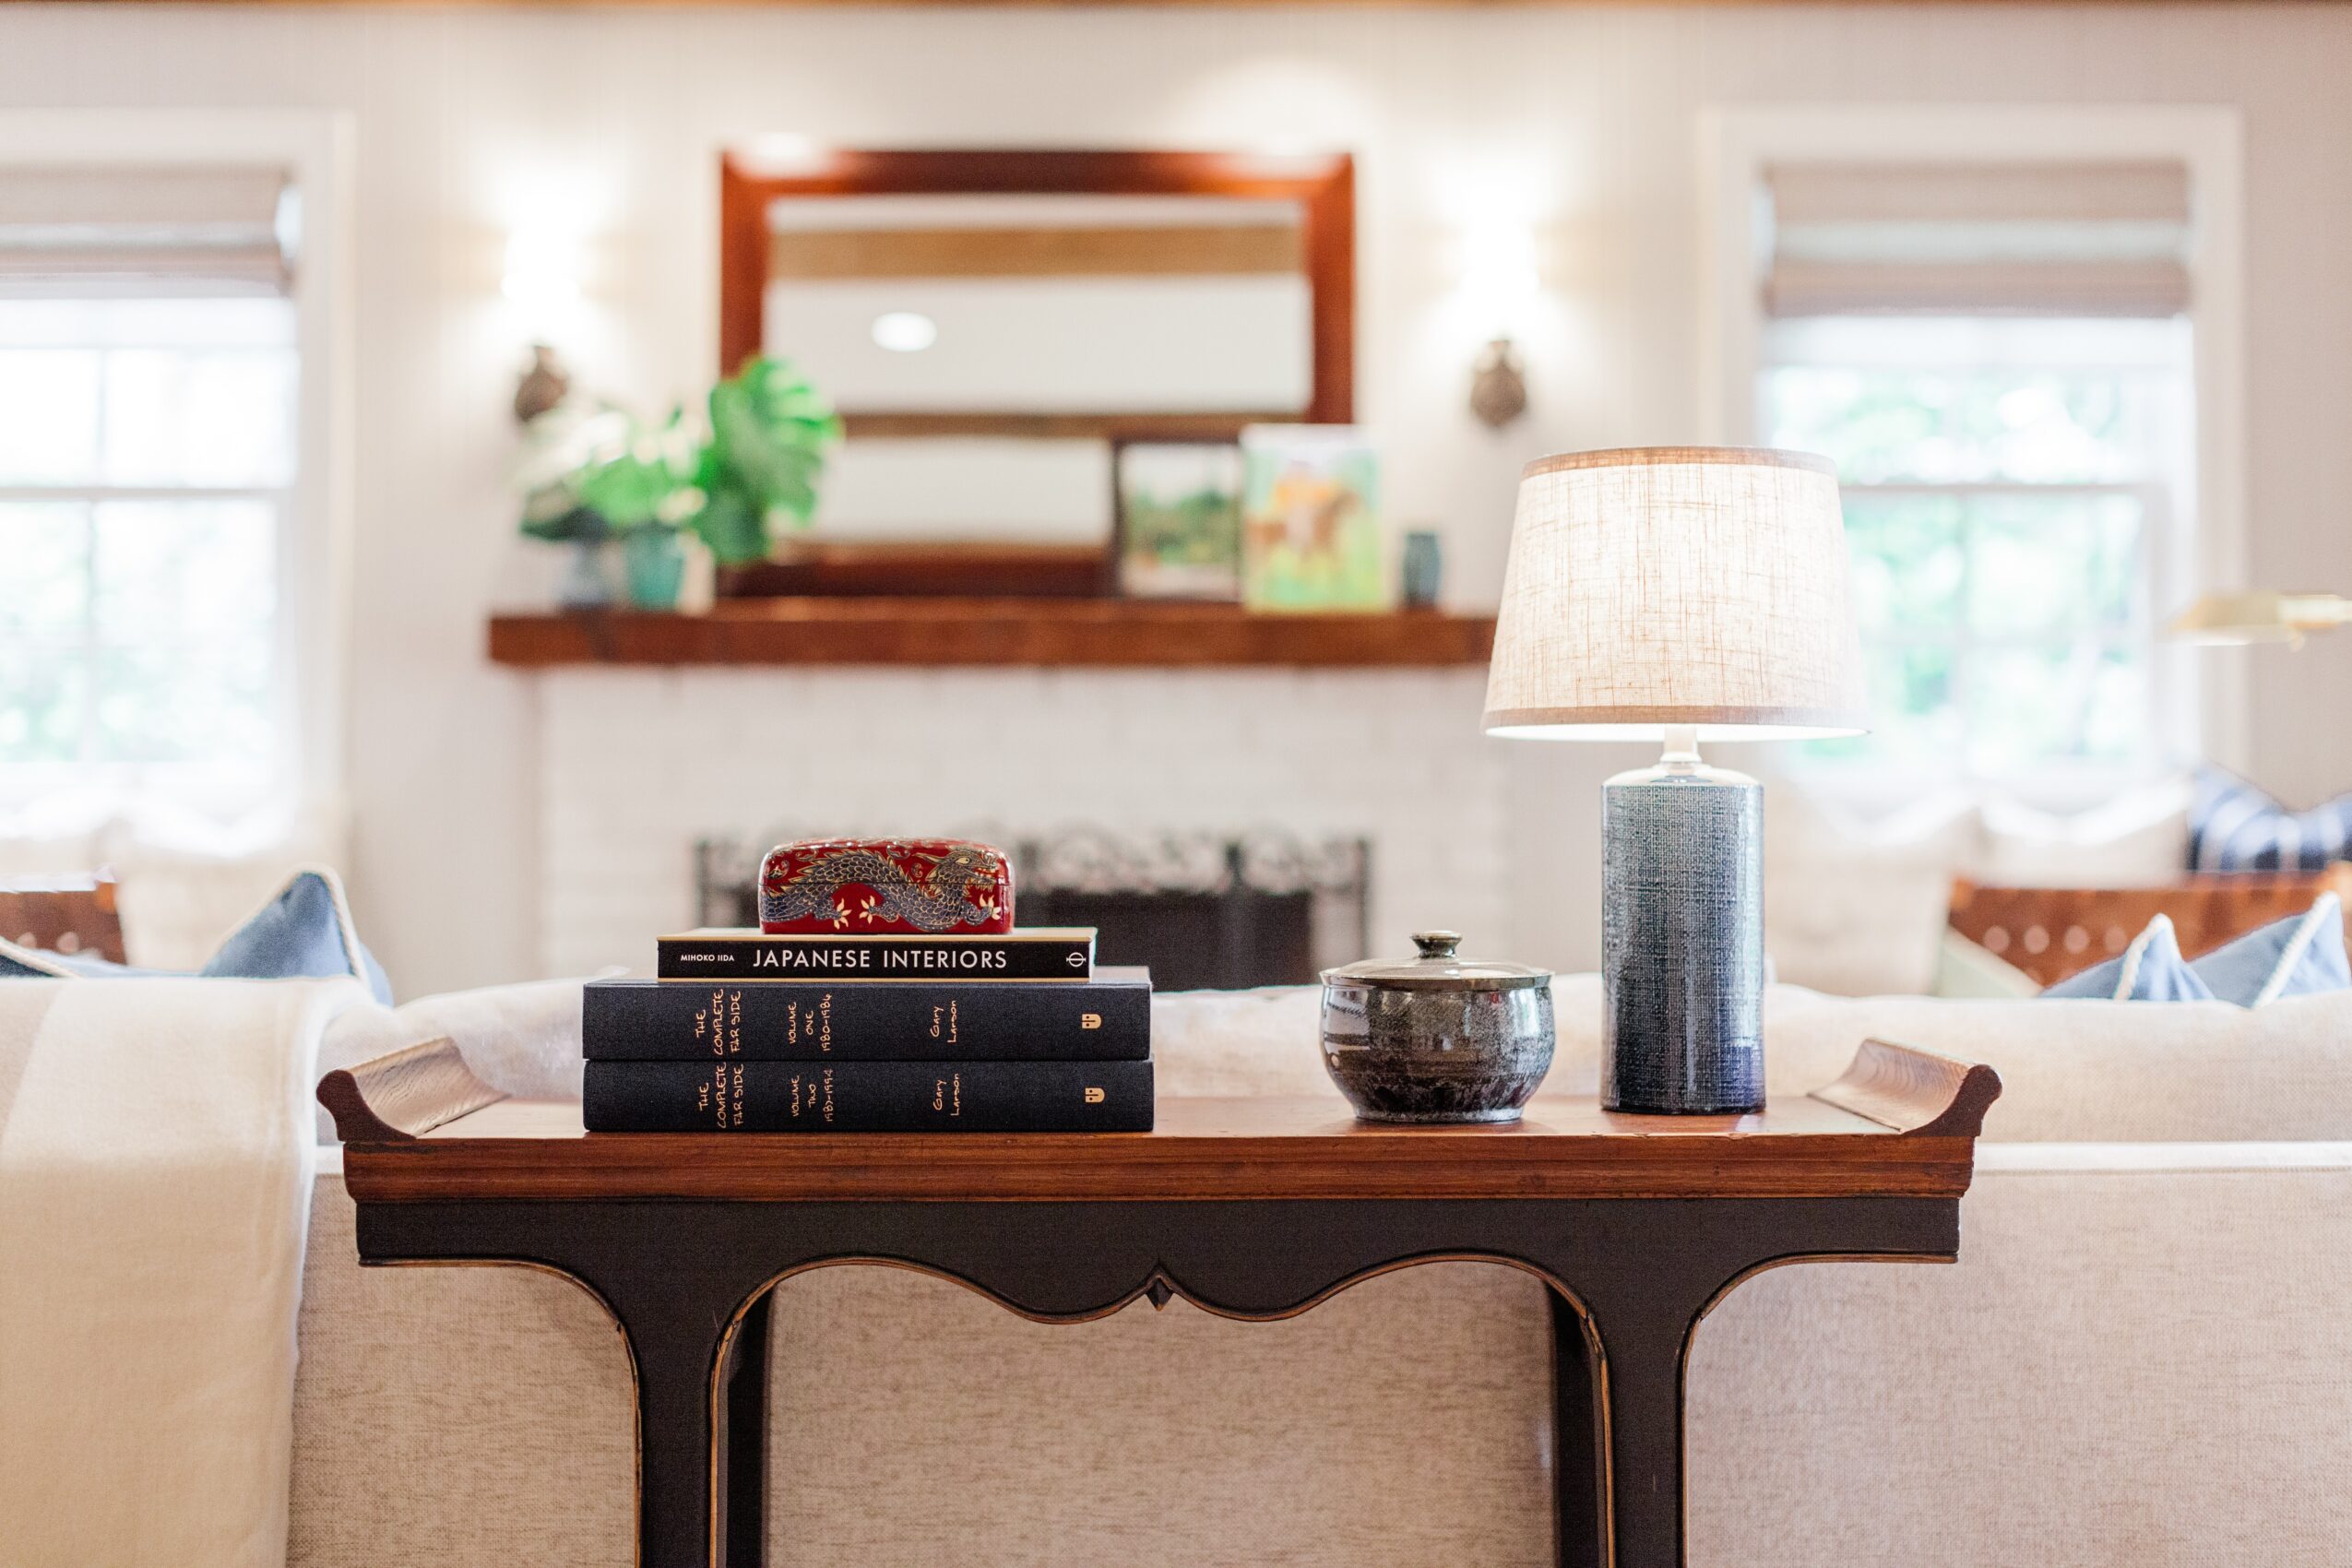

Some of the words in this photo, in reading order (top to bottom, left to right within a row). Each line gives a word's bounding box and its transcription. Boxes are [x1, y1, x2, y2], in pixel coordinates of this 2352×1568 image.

[680, 954, 716, 962] MIHOKO
[717, 954, 735, 962] IIDA
[753, 949, 871, 968] JAPANESE
[884, 950, 1007, 968] INTERIORS
[695, 1008, 707, 1039] THE
[712, 988, 724, 1056] COMPLETE
[730, 990, 742, 1026] SIDE
[788, 1001, 797, 1044] VOLUME
[805, 1010, 814, 1036] ONE
[819, 993, 833, 1051] 1980-1986
[930, 1005, 944, 1038] Gary
[946, 1000, 957, 1043] Larson
[730, 1028, 741, 1053] FAR
[698, 1082, 709, 1111] THE
[715, 1062, 727, 1129] COMPLETE
[733, 1063, 744, 1099] SIDE
[790, 1075, 800, 1117] VOLUME
[807, 1083, 817, 1108] TWO
[932, 1079, 947, 1111] Gary
[950, 1073, 960, 1116] Larson
[733, 1100, 743, 1125] FAR
